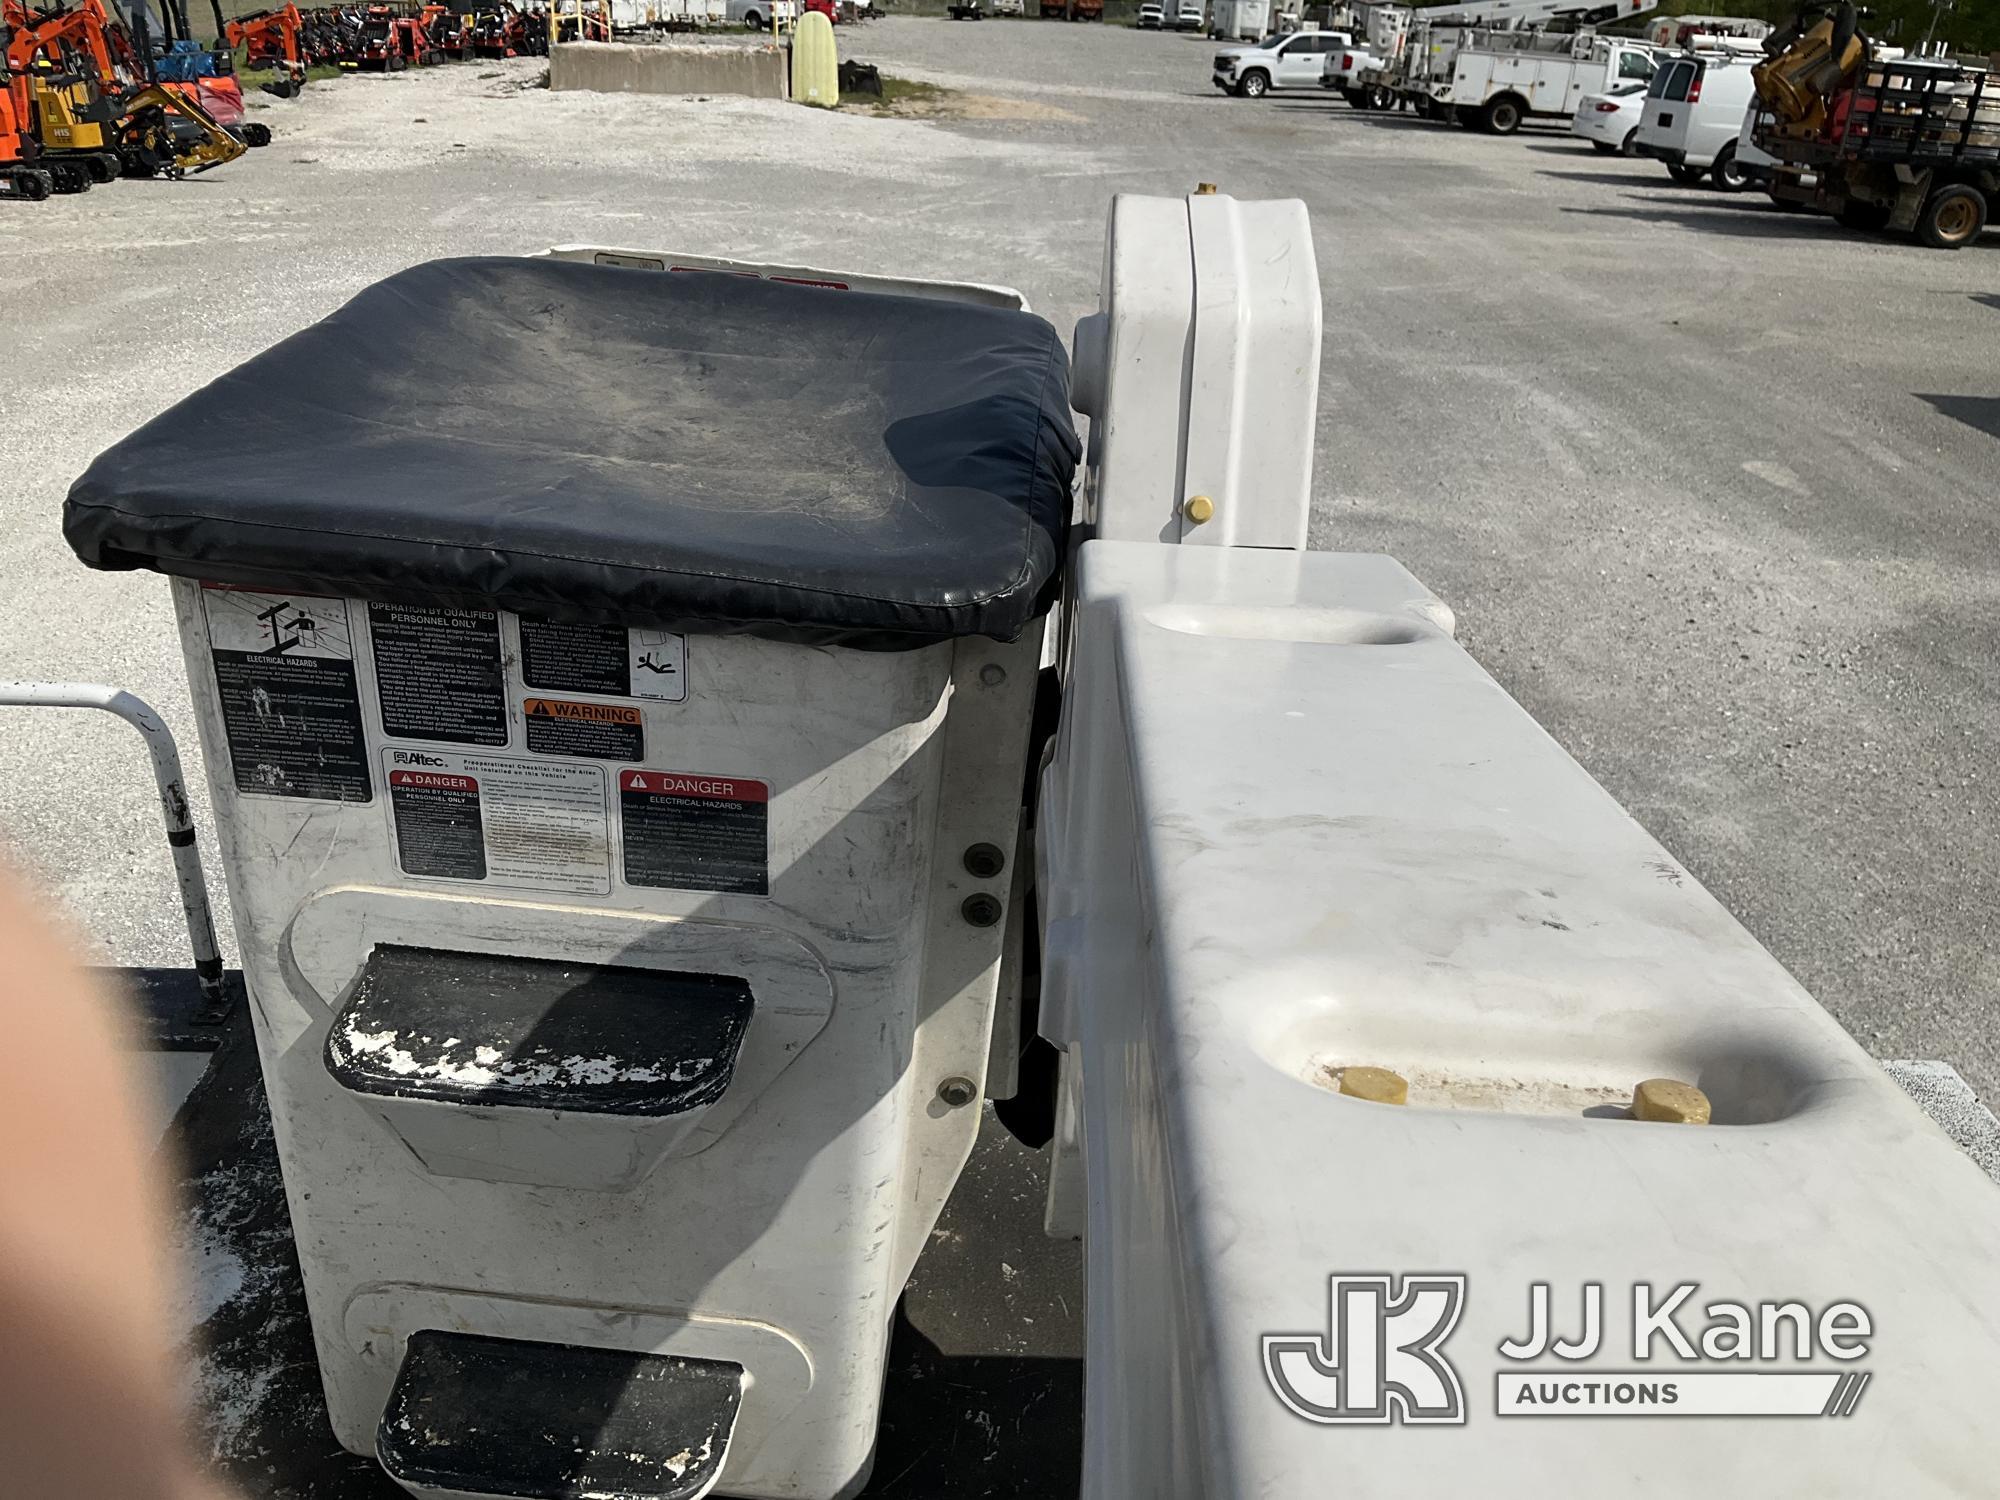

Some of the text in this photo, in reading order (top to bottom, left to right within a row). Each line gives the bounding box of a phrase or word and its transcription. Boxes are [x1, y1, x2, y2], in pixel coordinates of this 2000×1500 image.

[371, 602, 425, 614] OPERATION
[443, 608, 494, 619] QUALIFIED
[391, 613, 476, 628] PERSONNEL ONLY
[247, 655, 317, 667] ELECTRICAL HAZARDS
[554, 704, 635, 721] WARNING
[408, 752, 444, 767] Altec
[463, 759, 515, 769] Preoperational
[517, 764, 550, 772] Checklist
[578, 768, 596, 776] Altec
[464, 764, 478, 772] Unit
[540, 771, 566, 779] Vehicle
[416, 775, 467, 787] DANGER
[663, 777, 733, 796] DANGER
[392, 785, 430, 794] OPERATION
[442, 789, 478, 798] QUALIFIED
[406, 793, 465, 804] PERSONNEL ONLY
[650, 795, 742, 810] ELECTRICAL HAZARDS
